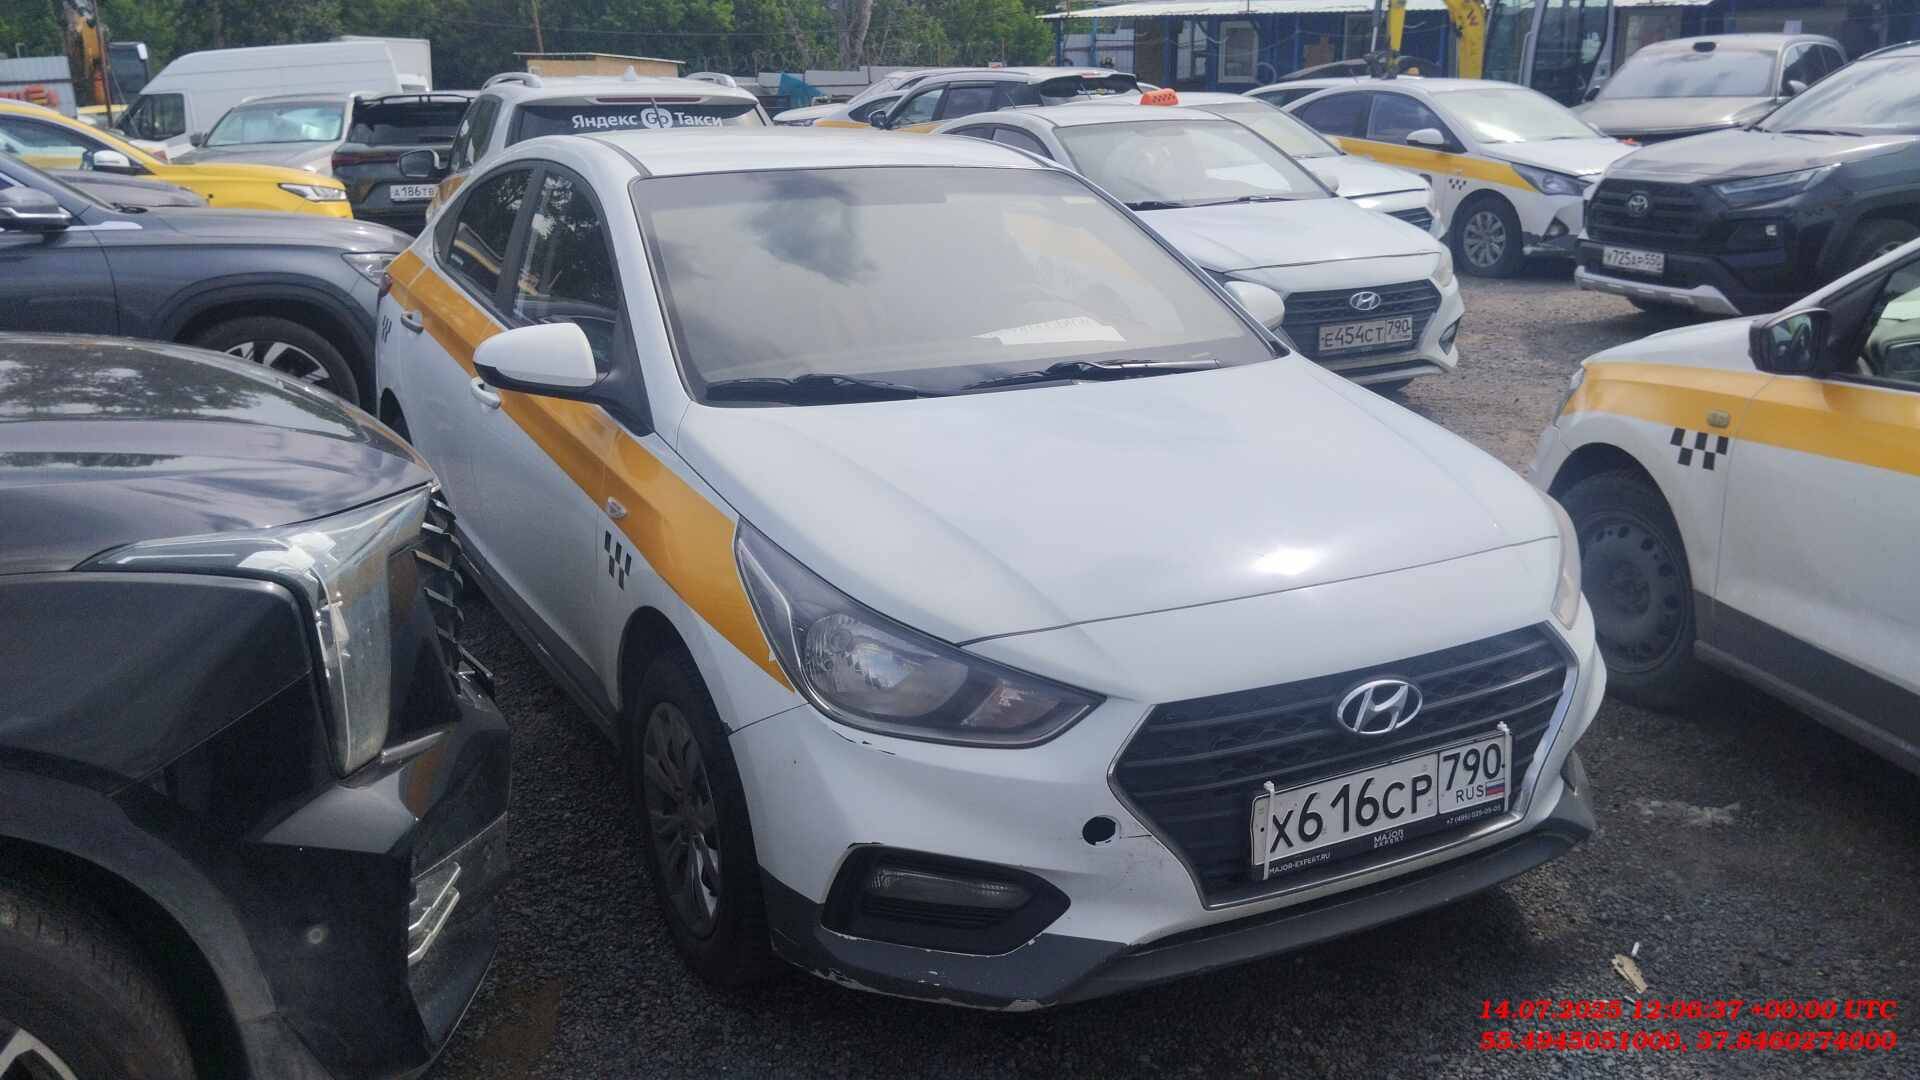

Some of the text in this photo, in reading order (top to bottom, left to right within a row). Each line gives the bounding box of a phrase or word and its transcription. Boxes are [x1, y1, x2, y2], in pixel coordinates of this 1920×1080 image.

[571, 113, 638, 129] Яндекс
[674, 112, 724, 127] Такси
[1270, 742, 1502, 854] Х616СР 790
[1455, 784, 1484, 804] RUS
[1373, 829, 1404, 843] MAJOR
